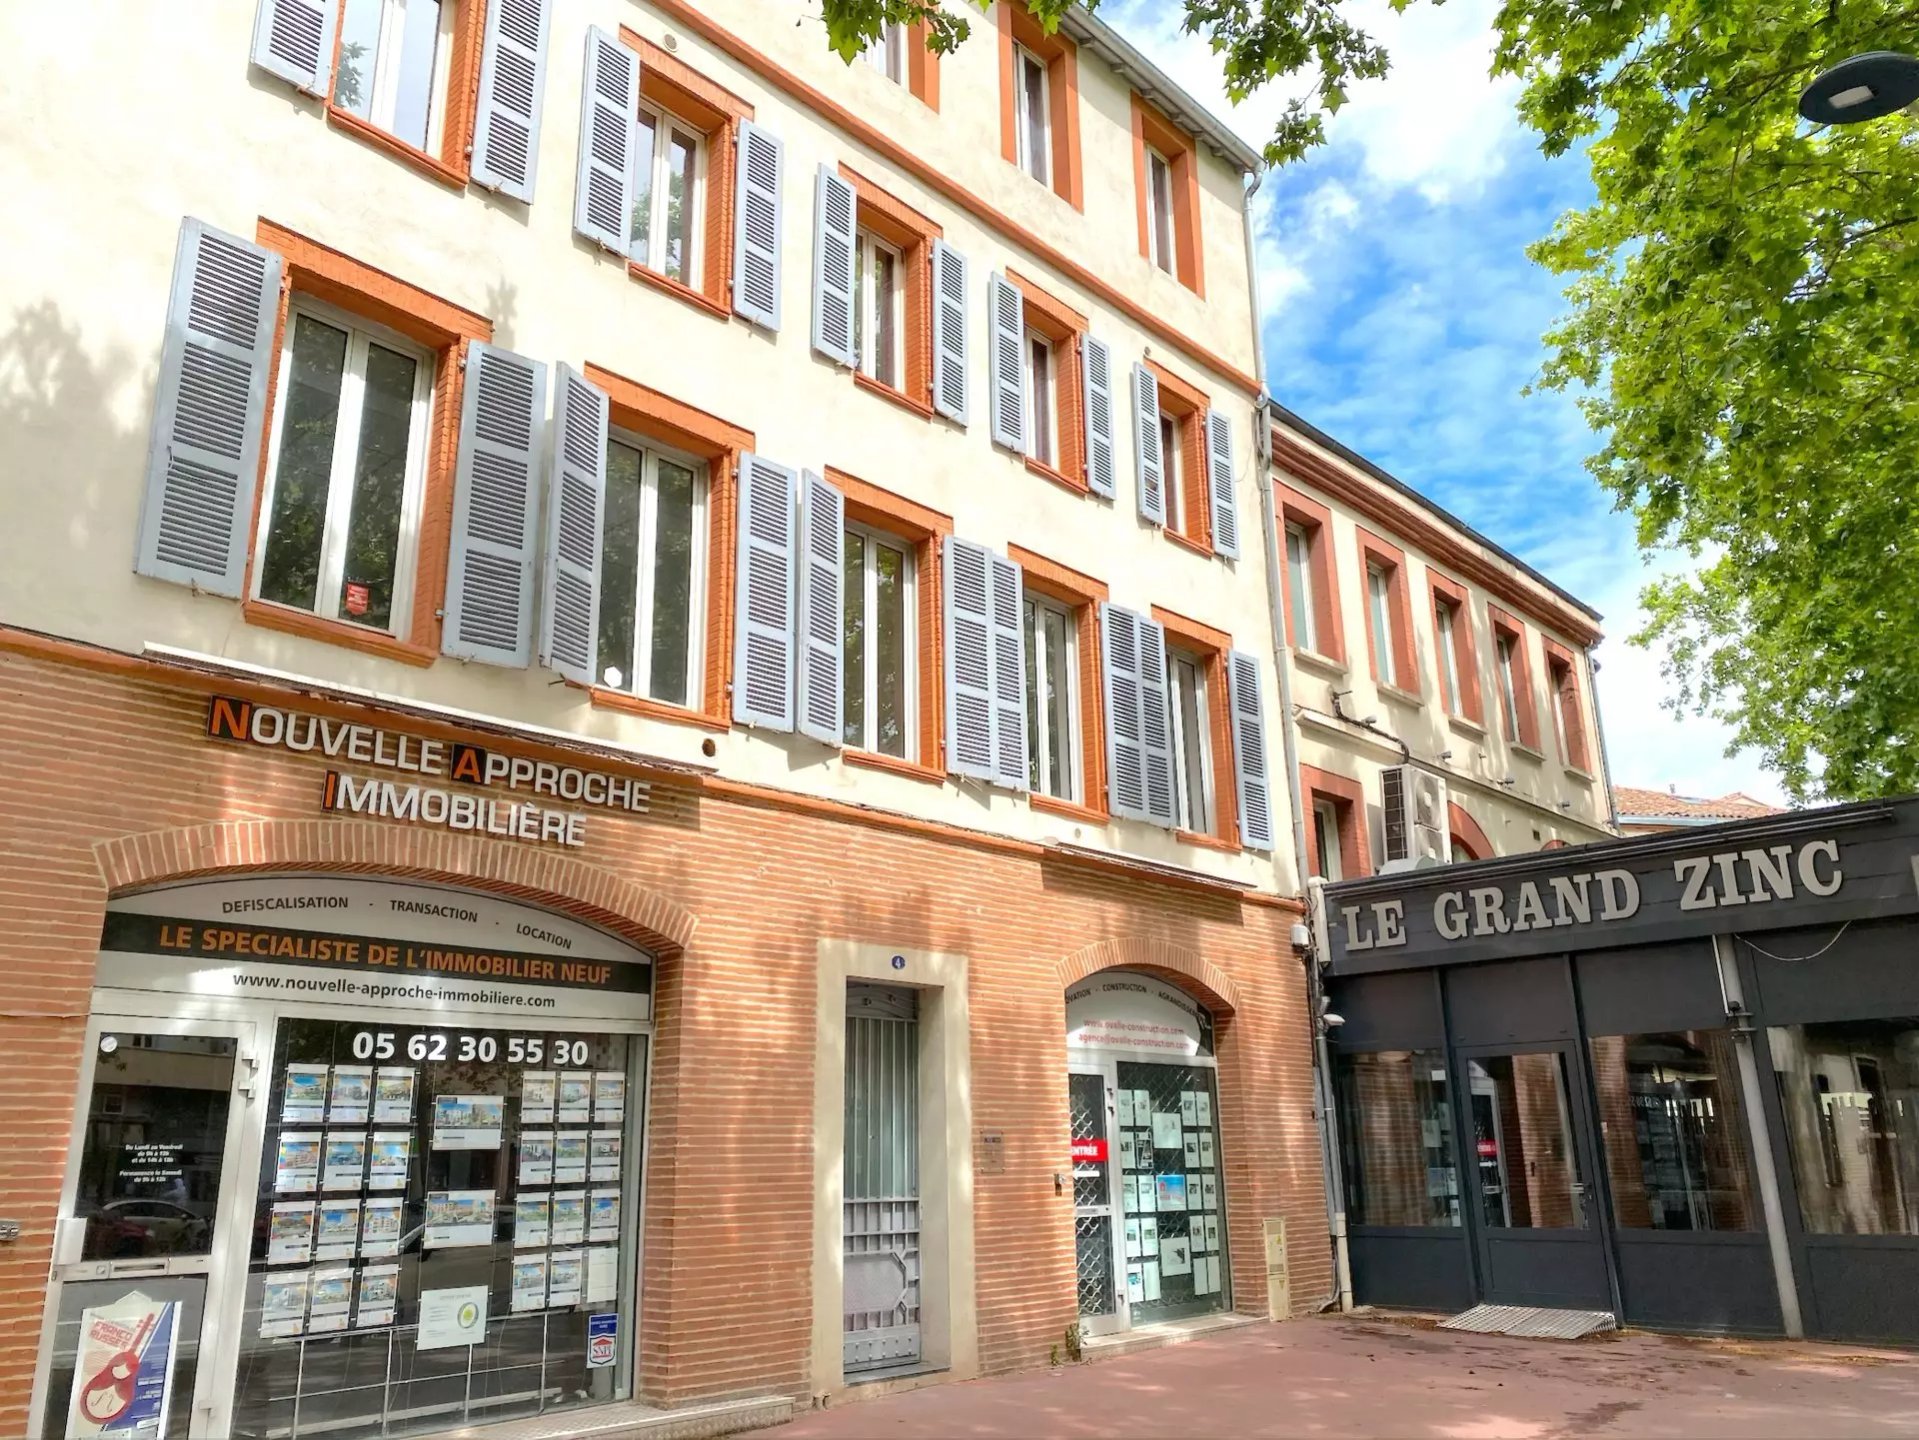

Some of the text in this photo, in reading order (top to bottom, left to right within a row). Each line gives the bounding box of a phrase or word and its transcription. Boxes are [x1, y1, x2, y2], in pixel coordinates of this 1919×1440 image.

[211, 699, 651, 813] NOUVELLE APPROCHE
[326, 774, 587, 847] IMMOBILIÈRE
[1341, 899, 1407, 951] LE
[1433, 868, 1640, 940] GRAND
[1673, 839, 1843, 911] ZINC
[222, 896, 573, 950] DEFISCALISATION TRANSACTION LOCATION
[159, 925, 612, 984] LE SPECIALISTE DE L'IMMOBILIER NEUF
[232, 974, 555, 1008] www.nouvelle-approche-immobiliere.com
[1102, 982, 1147, 994] CONSTRUCTION
[352, 1031, 589, 1066] 05 62 30 55 30
[95, 1320, 133, 1341] FRANCO
